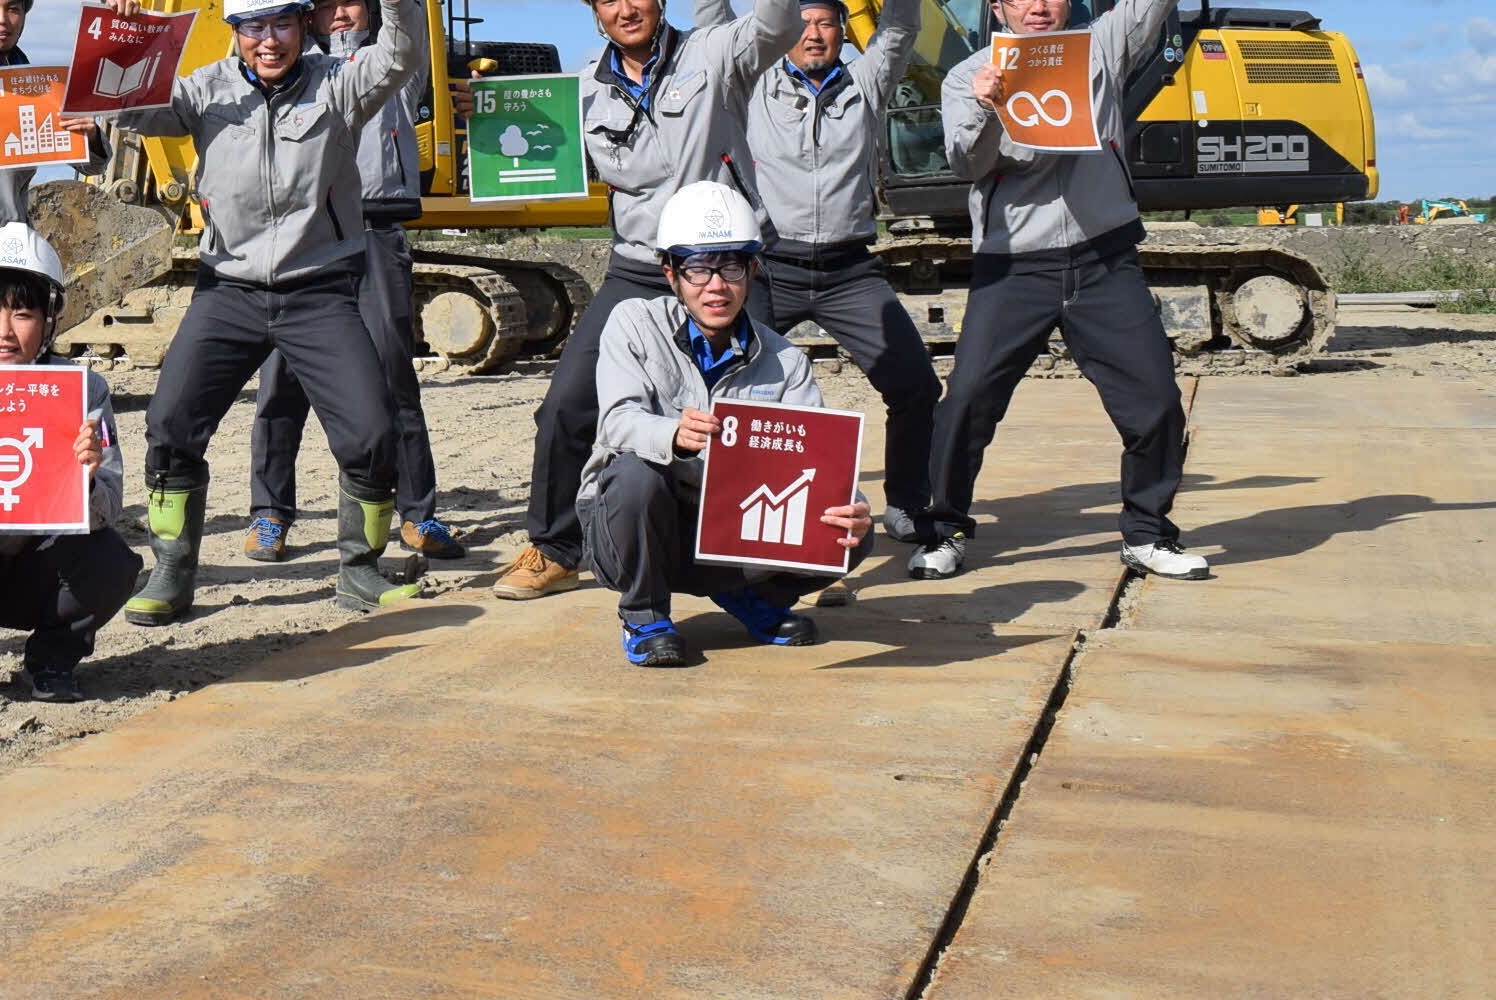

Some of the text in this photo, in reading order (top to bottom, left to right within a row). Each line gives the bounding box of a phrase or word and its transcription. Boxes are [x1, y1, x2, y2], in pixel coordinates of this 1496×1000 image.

[87, 16, 102, 40] 4
[108, 32, 144, 44] みんなに
[1029, 43, 1064, 55] つくる責任
[998, 47, 1021, 70] 12
[1027, 56, 1064, 67] つかう責任
[10, 74, 59, 85] 住み続けられる
[11, 83, 51, 95] まちづくりを
[474, 90, 496, 114] 15
[504, 102, 527, 112] 守ろう
[1197, 135, 1309, 161] SH200
[1199, 163, 1241, 172] SUMITOMO
[698, 230, 733, 239] IWANAMI
[720, 415, 739, 447] 8
[750, 418, 807, 437] 働きがいも
[748, 435, 804, 453] 経済成長も
